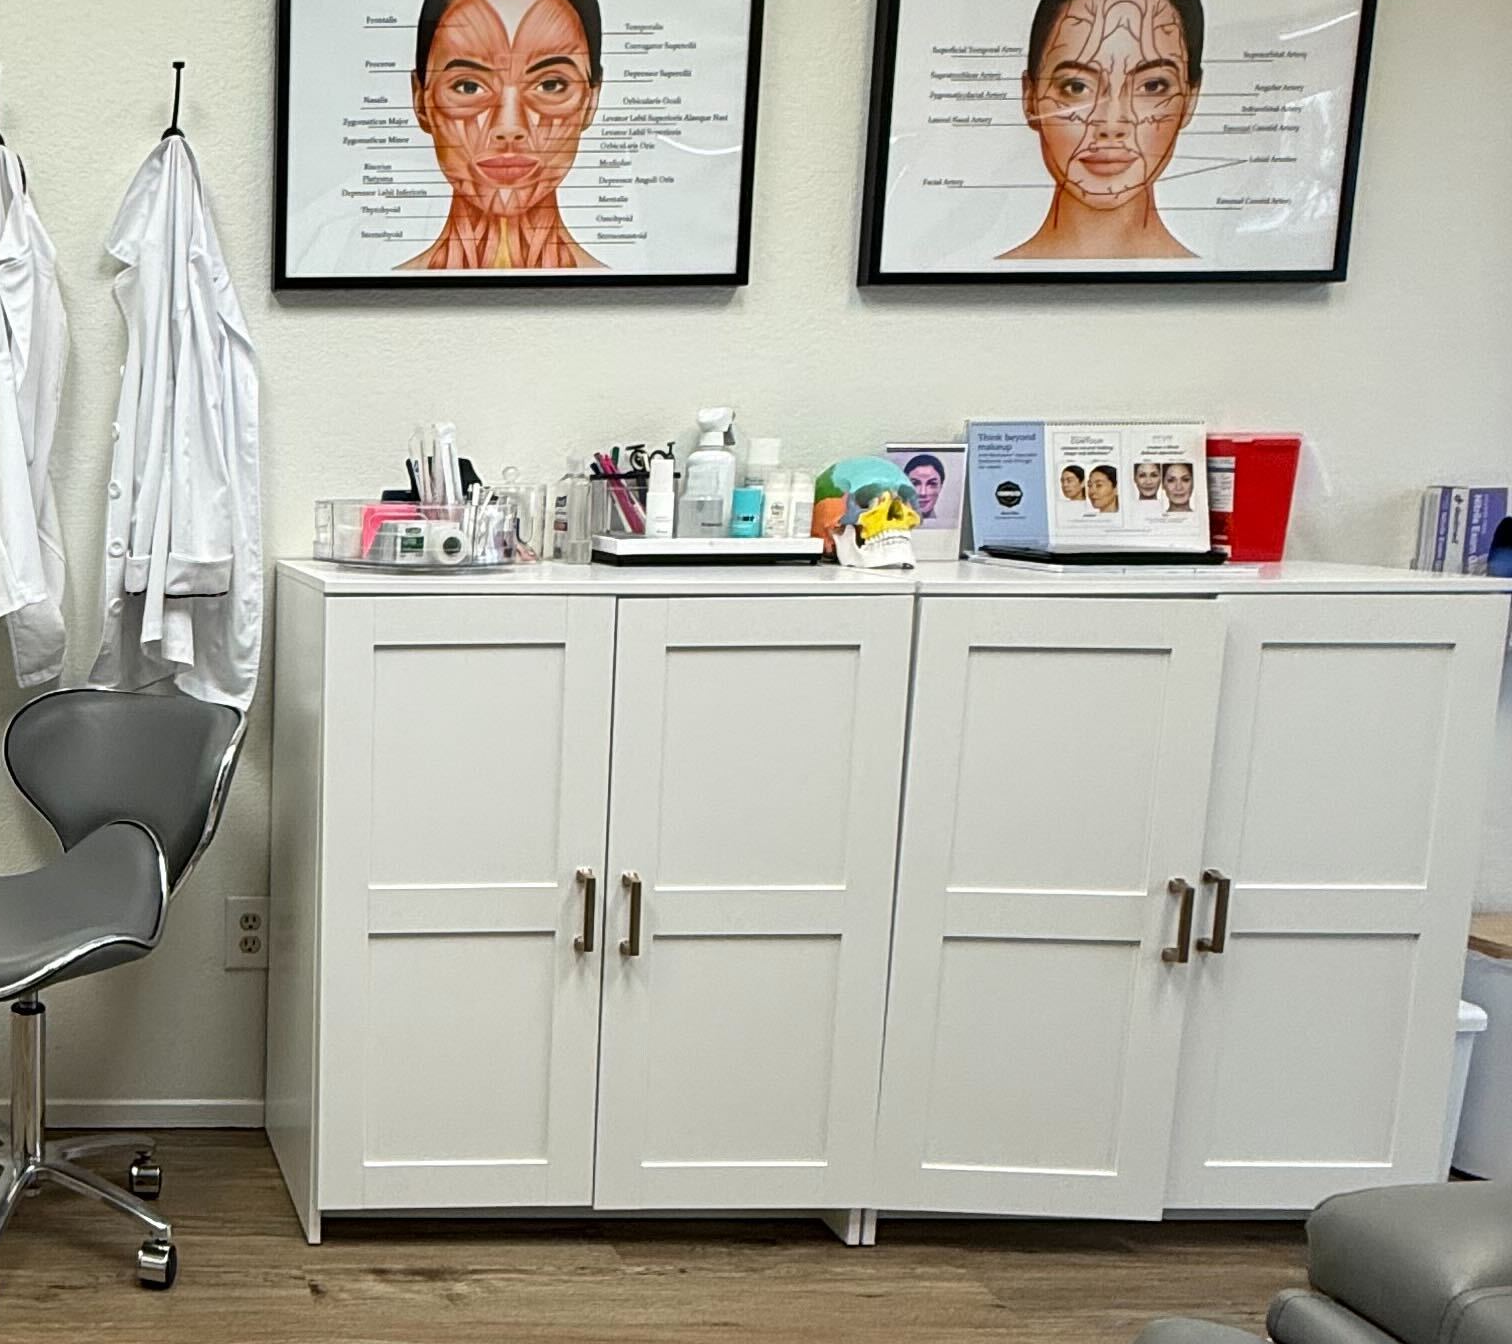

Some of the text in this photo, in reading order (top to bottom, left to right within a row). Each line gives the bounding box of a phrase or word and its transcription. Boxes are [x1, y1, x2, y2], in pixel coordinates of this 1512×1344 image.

[388, 117, 409, 126] Major
[388, 136, 409, 145] Minor
[977, 433, 1037, 443] Think beyond
